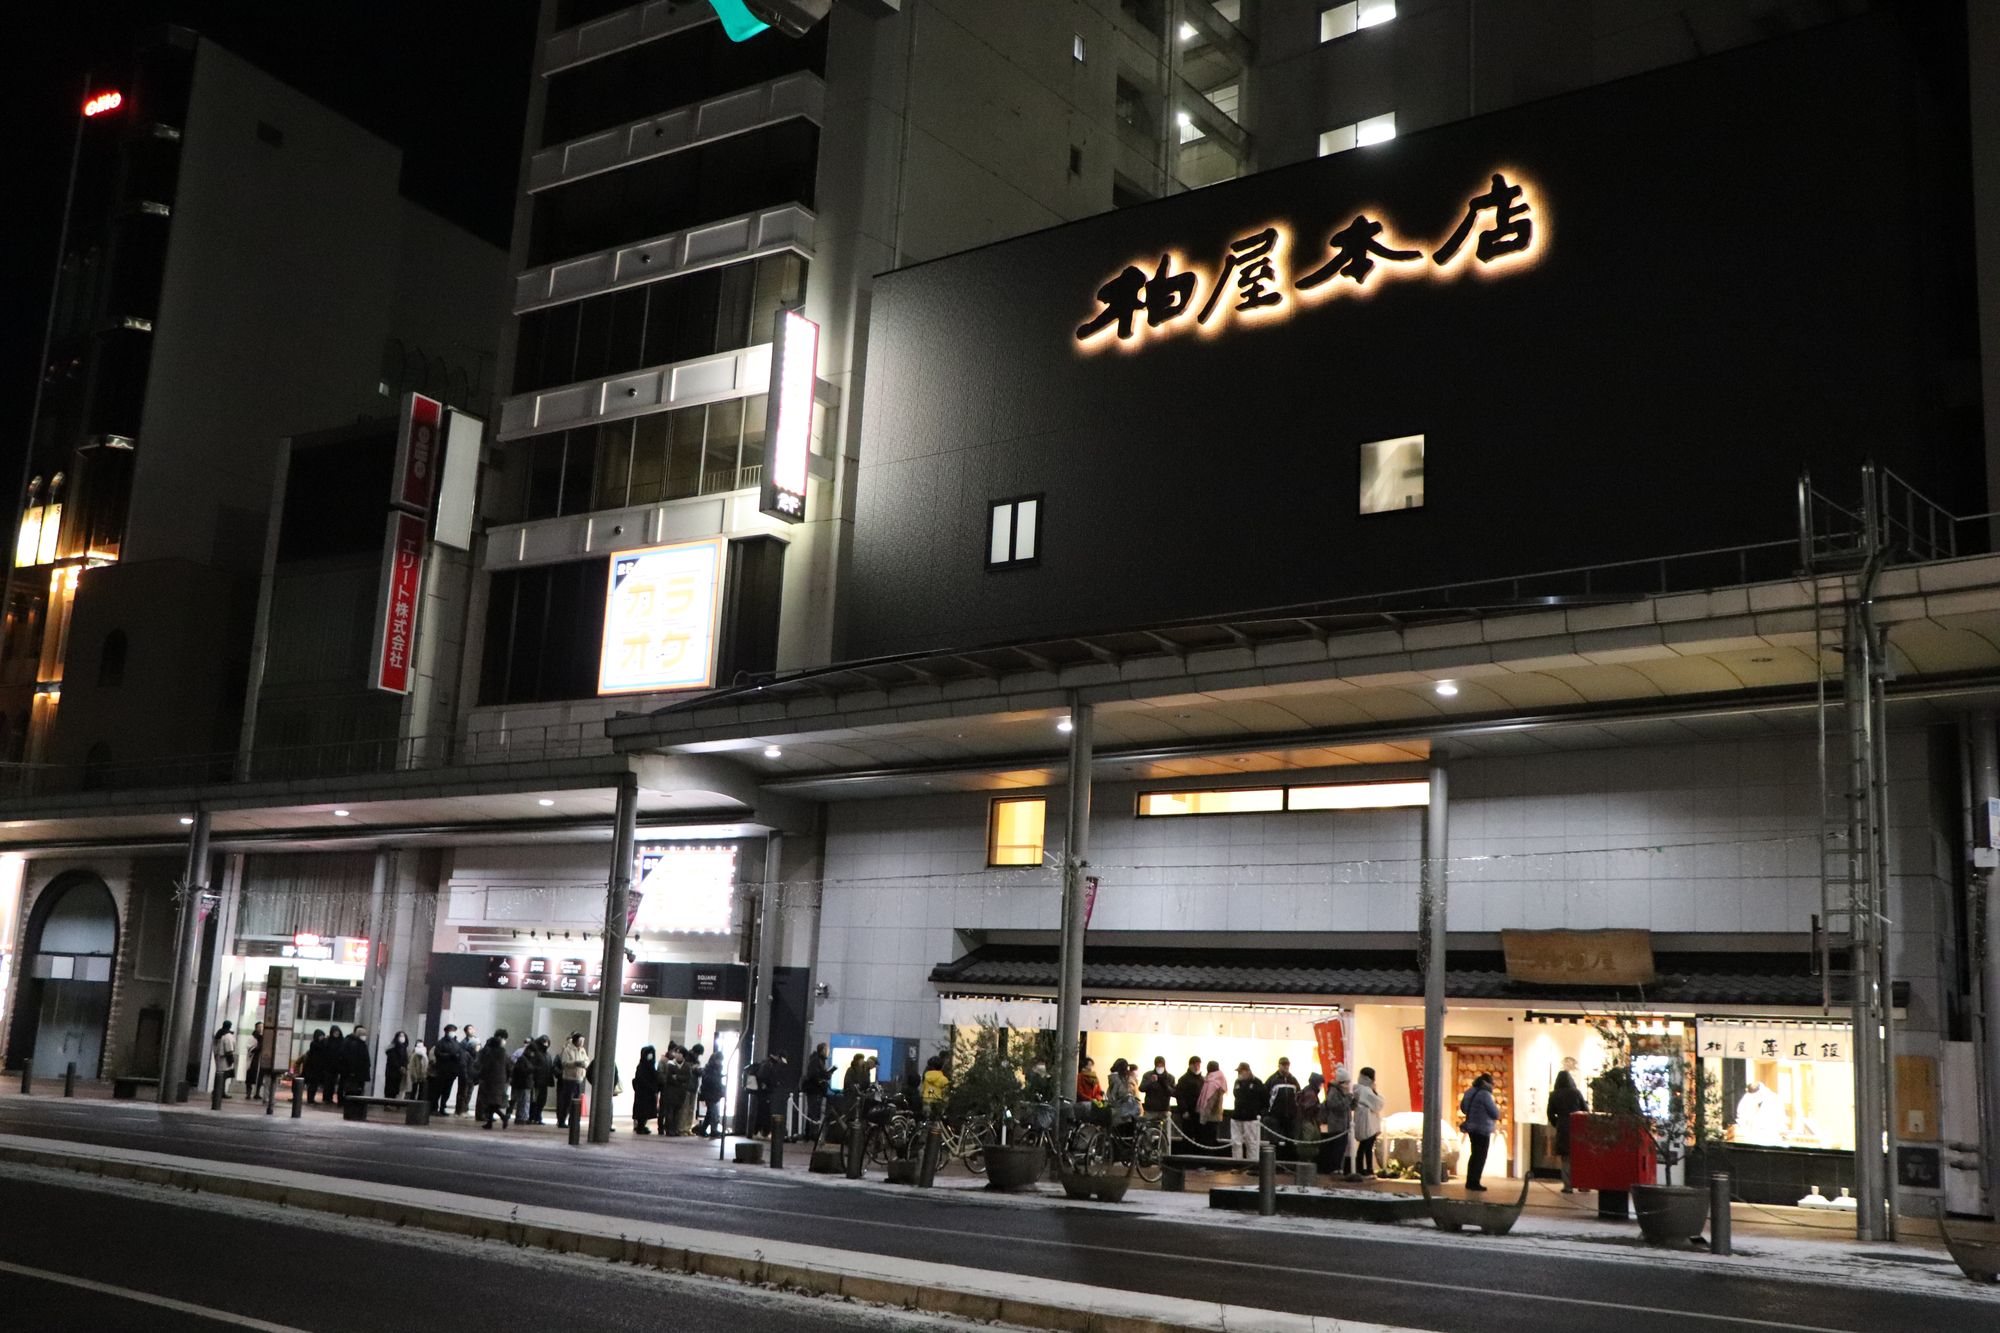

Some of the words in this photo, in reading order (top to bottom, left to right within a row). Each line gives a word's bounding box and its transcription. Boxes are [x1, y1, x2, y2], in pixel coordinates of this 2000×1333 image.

[1075, 173, 1533, 342] 柏屋本店
[616, 561, 635, 576] 2F
[389, 539, 415, 668] エリート株式会社
[626, 577, 694, 616] カラ
[622, 631, 691, 670] オケ
